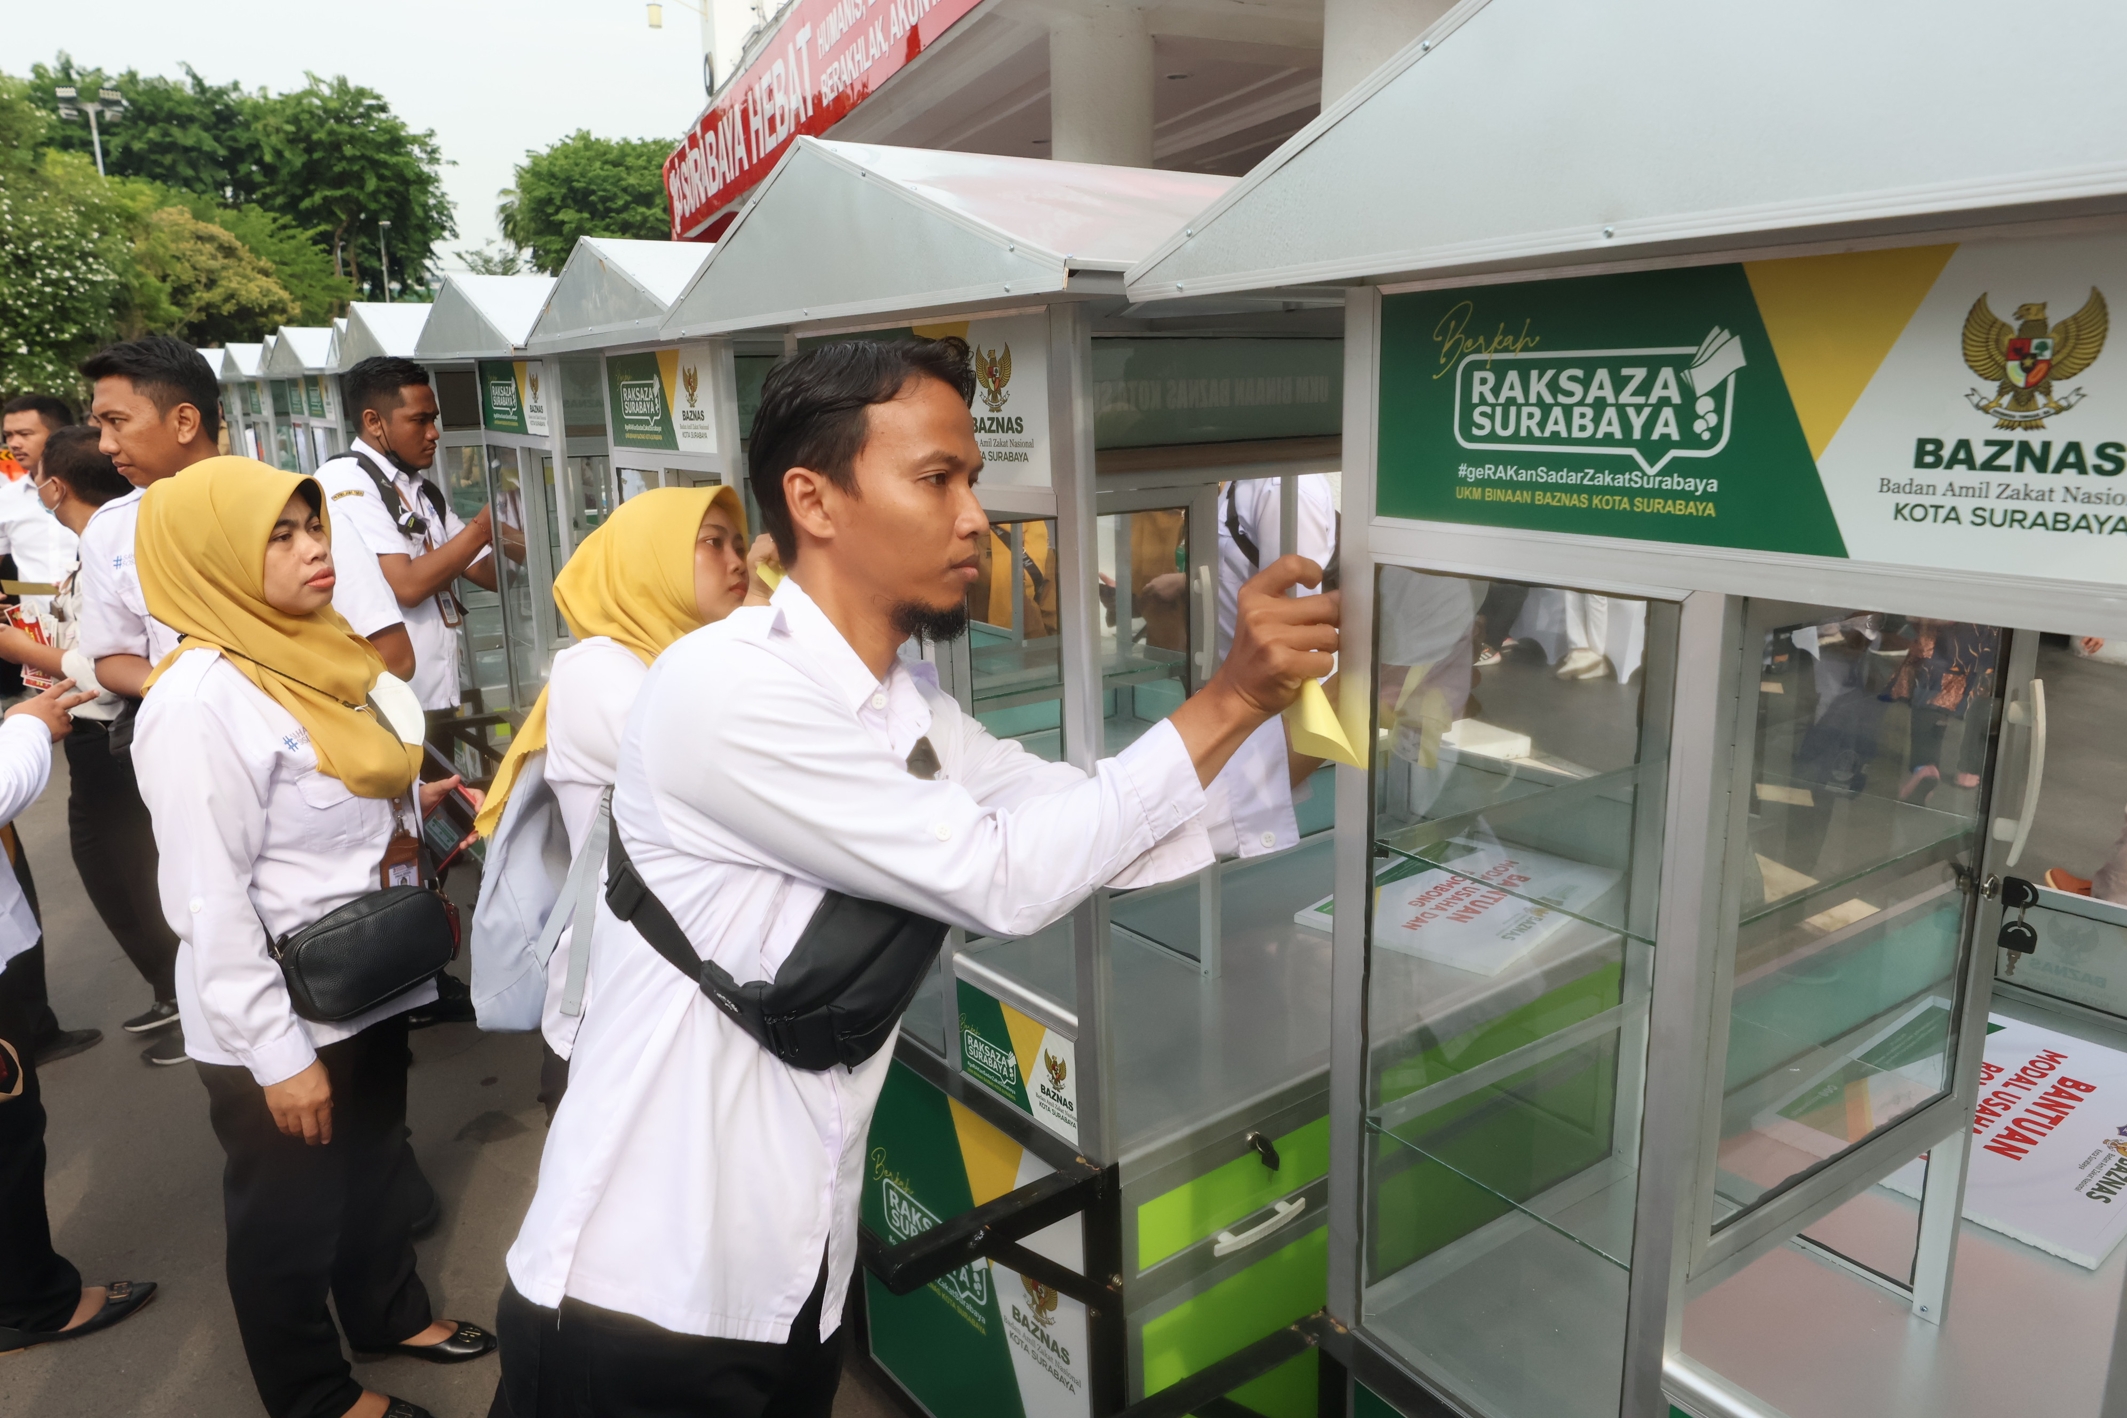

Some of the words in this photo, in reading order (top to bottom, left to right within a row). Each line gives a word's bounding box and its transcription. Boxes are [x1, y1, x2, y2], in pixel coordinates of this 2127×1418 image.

[820, 15, 890, 108] BERAKHLAK,
[748, 21, 814, 165] HEBAT
[623, 387, 654, 401] RAKSAZA
[1471, 366, 1682, 405] RAKSAZA
[624, 401, 655, 414] SURABAYA
[682, 410, 705, 421] BAZNAS
[1471, 405, 1681, 441] SURABAYA
[988, 450, 1029, 463] SURABAYA
[993, 438, 1009, 448] Zakat
[1009, 438, 1035, 448] Nasional
[1913, 437, 2127, 477] BAZNAS
[1457, 463, 1719, 496] #geRAKanSadarZakatSurabaya
[1877, 477, 1937, 497] Badan
[1941, 481, 1991, 499] Amil
[1994, 482, 2055, 504] Zakat
[2061, 486, 2127, 506] Nasio
[1455, 486, 1482, 500] UKM
[1485, 487, 1532, 504] BINAAN
[1534, 490, 1589, 508] BAZNAS
[1592, 494, 1631, 511] KOTA
[1633, 496, 1717, 518] SURABAYA
[1893, 502, 1962, 525] KOTA
[1969, 506, 2127, 536] SURABAYA
[1429, 886, 1481, 912] USAHA
[1401, 911, 1440, 931] DAN
[967, 1034, 1008, 1068] RAKSAZA
[968, 1045, 1009, 1078] SURABAYA
[2001, 1049, 2068, 1091] MODAL
[1040, 1083, 1074, 1112] BAZNAS
[1038, 1100, 1052, 1115] KOTA
[1051, 1107, 1077, 1130] SURABAYA
[1983, 1076, 2097, 1161] BANTUAN
[1011, 1304, 1071, 1366] BAZNAS
[1003, 1315, 1021, 1336] Badan
[1022, 1330, 1036, 1348] Amil
[1036, 1343, 1054, 1364] Zakat
[1054, 1358, 1082, 1389] Nasional
[1009, 1330, 1030, 1355] KOTA
[1031, 1349, 1076, 1395] SURABAYA
